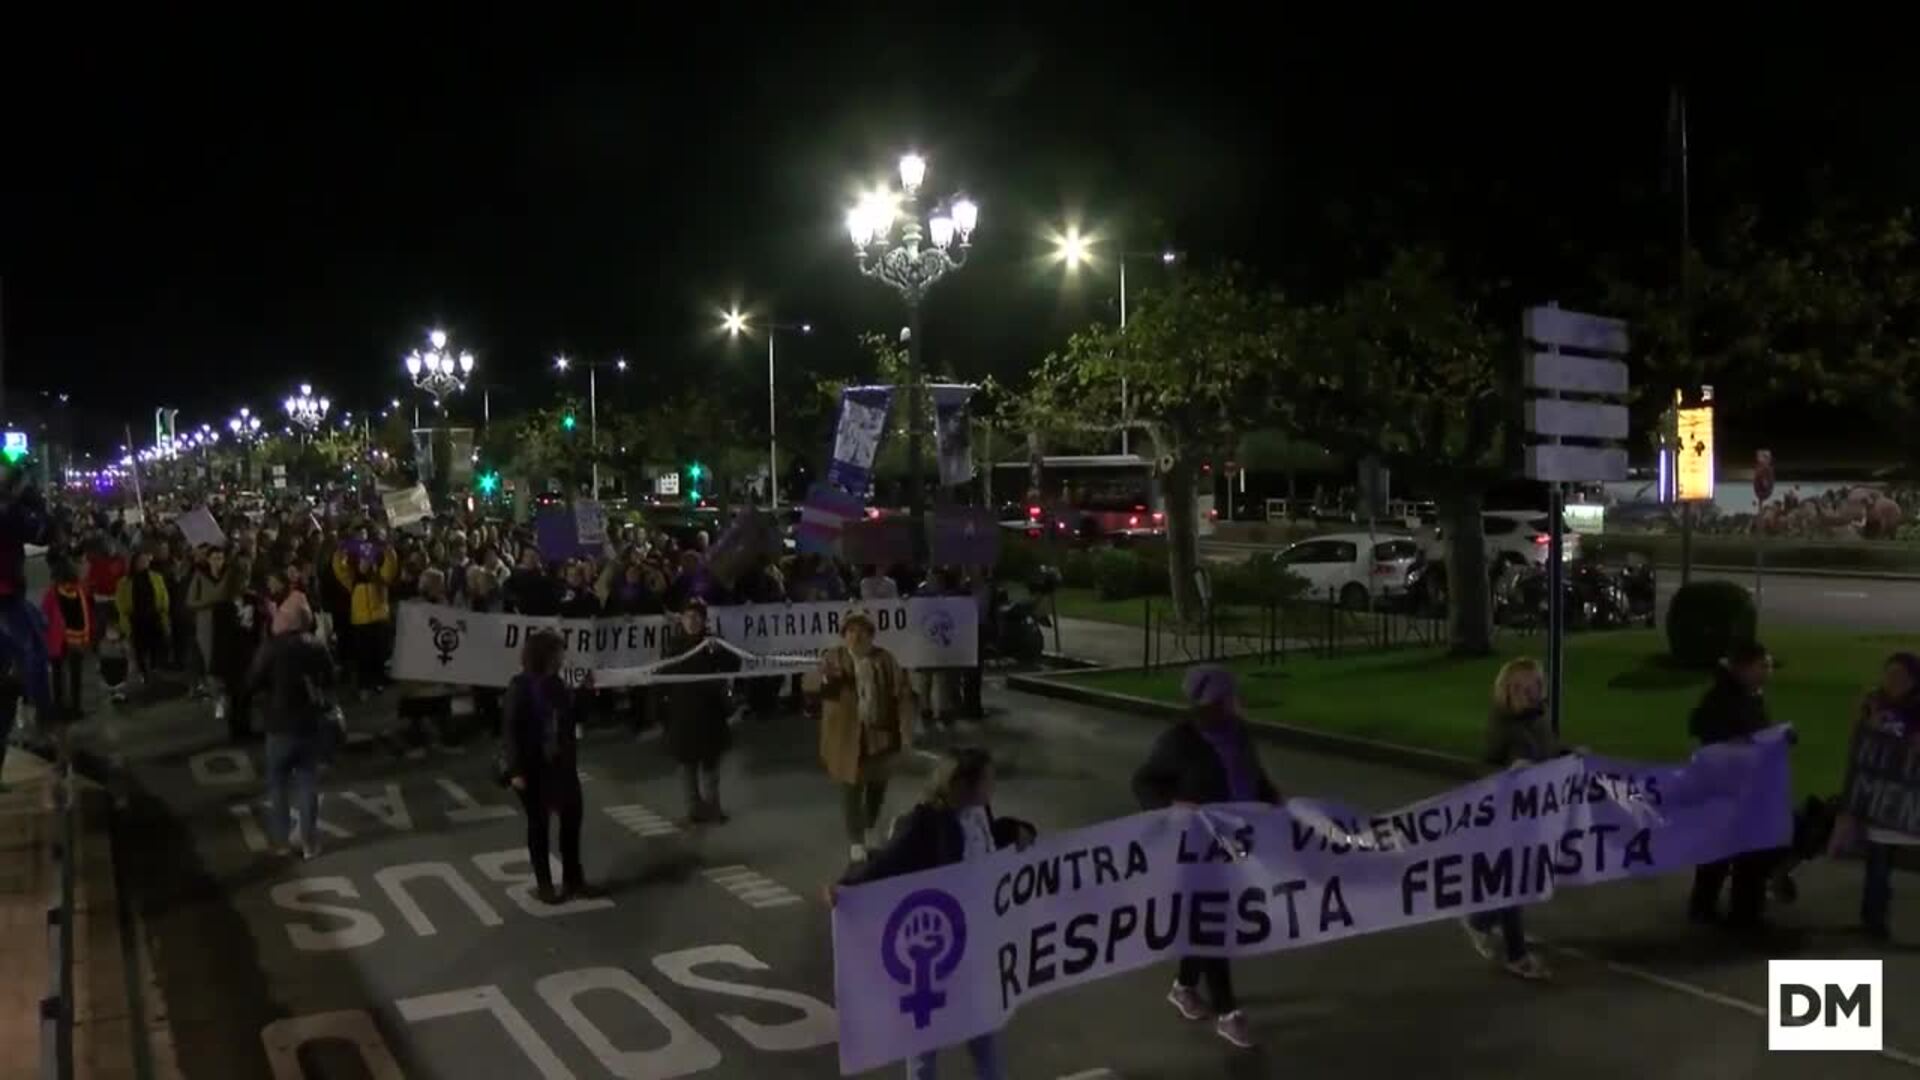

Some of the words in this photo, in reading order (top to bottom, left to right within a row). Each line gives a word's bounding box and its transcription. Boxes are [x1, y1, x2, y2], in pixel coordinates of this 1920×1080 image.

[744, 608, 907, 640] PATRIARDO
[269, 847, 616, 951] BUS
[995, 840, 1148, 916] CONTRA
[1177, 824, 1254, 864] LAS
[998, 875, 1354, 1010] RESPUESTA
